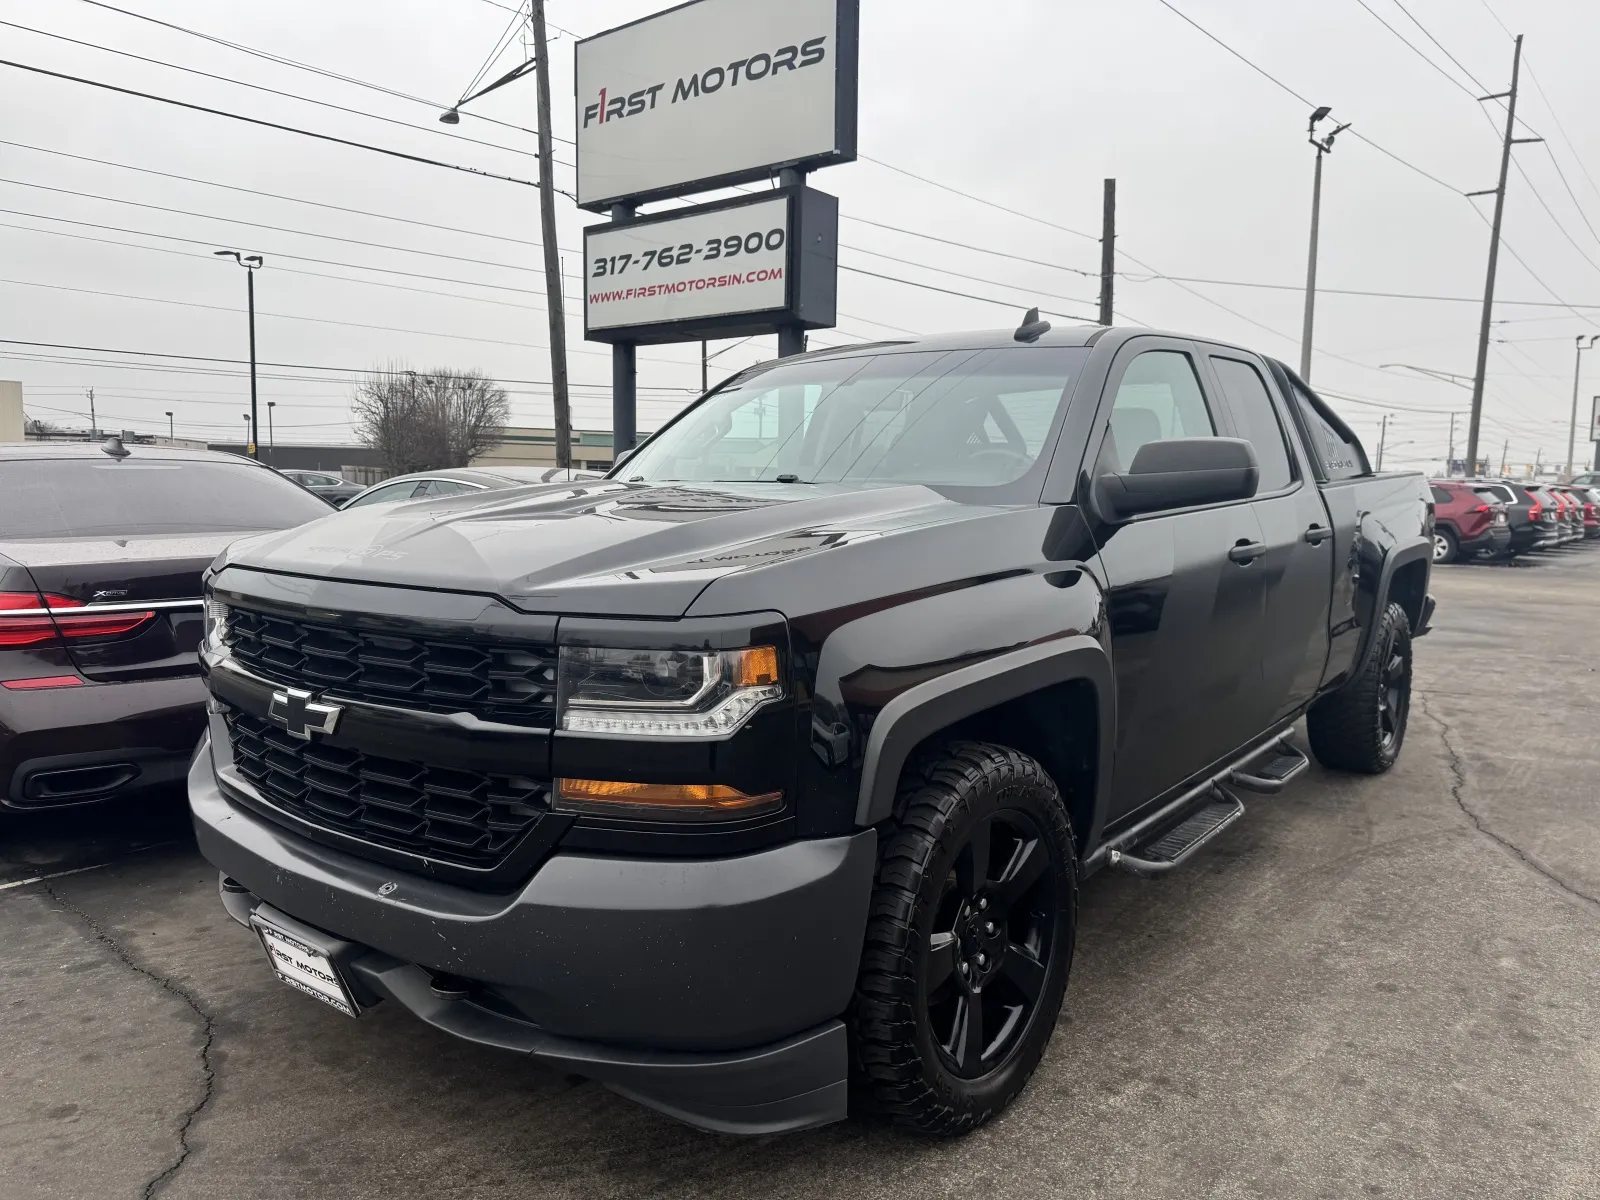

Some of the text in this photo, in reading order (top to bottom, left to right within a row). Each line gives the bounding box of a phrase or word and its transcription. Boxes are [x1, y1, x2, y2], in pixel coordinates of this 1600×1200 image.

[671, 36, 827, 104] MOTORS
[592, 228, 785, 278] 317-762-3900
[589, 267, 783, 304] WWW.FIRSTMOTORSIN.COM
